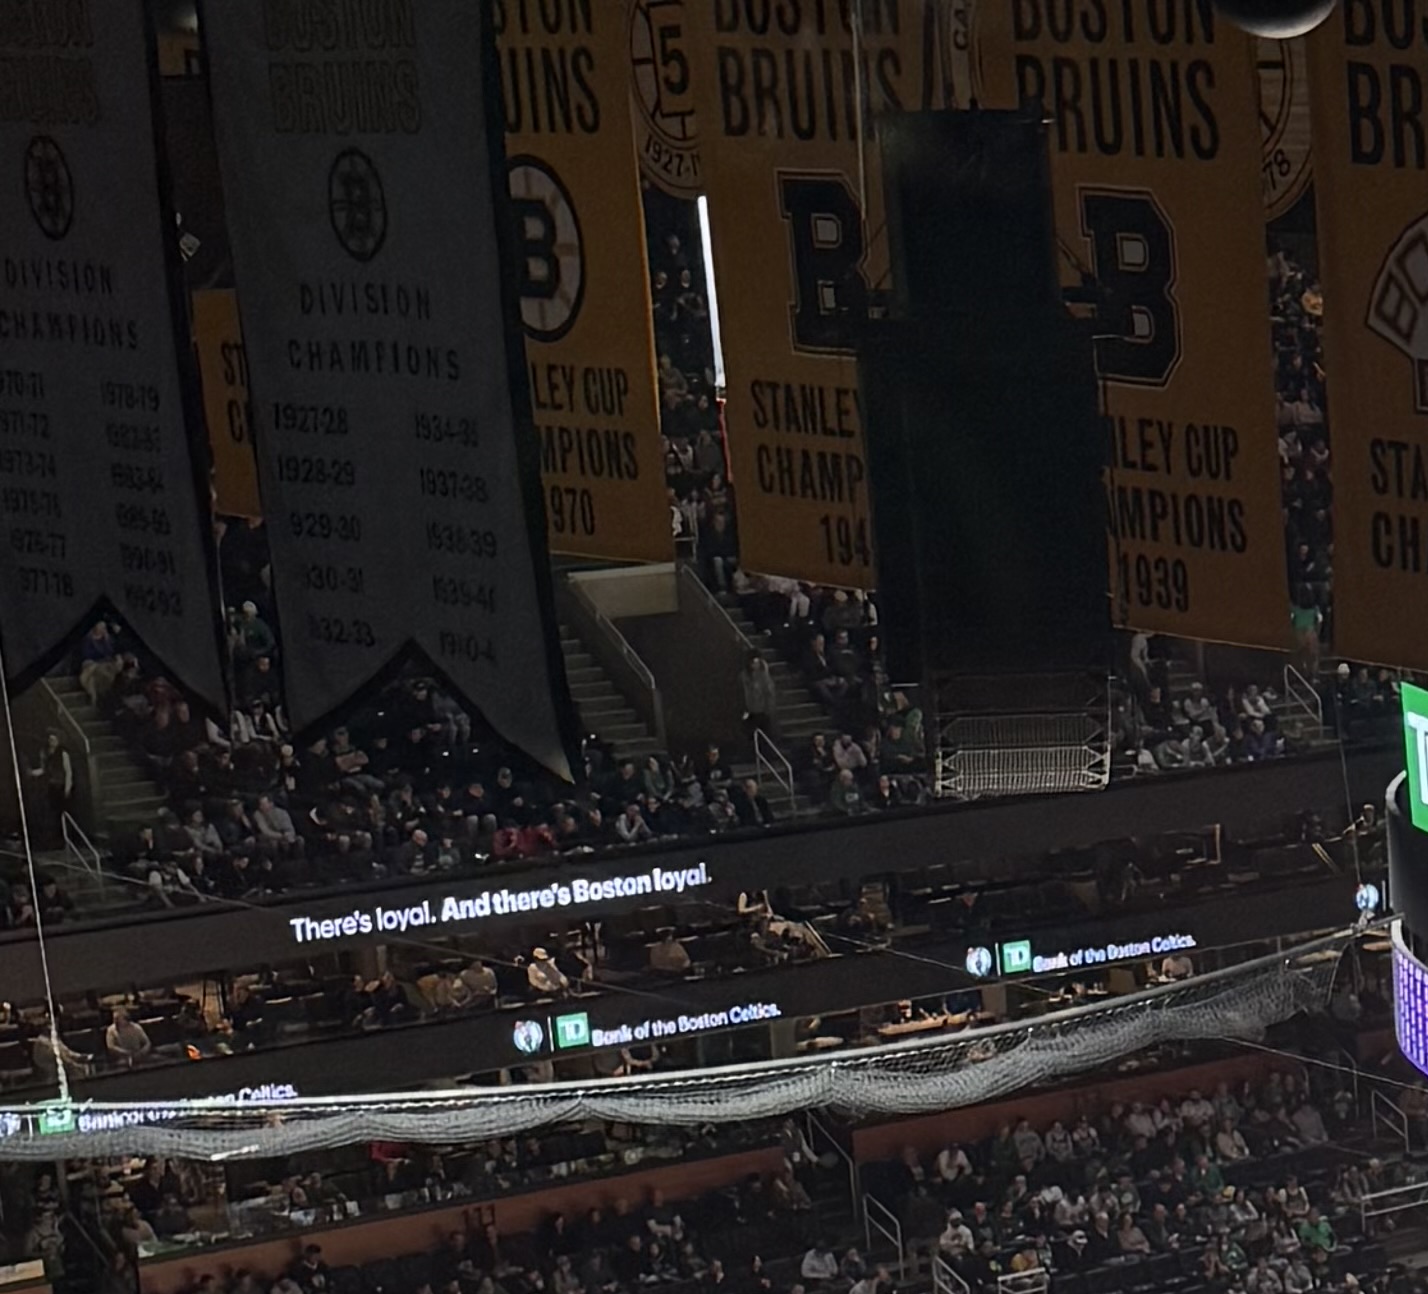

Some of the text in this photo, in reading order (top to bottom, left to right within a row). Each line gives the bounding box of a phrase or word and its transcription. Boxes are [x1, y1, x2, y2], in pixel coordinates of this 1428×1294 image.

[658, 29, 690, 95] 5
[268, 58, 421, 135] BRUINS
[299, 282, 432, 321] DIVISION
[287, 338, 462, 381] CHAMPIONS
[584, 366, 630, 418] CUP
[273, 402, 349, 436] 1927-28
[277, 454, 356, 487] 1928-29
[1184, 421, 1240, 481] CUP
[1119, 552, 1190, 613] 1939
[289, 862, 714, 944] There's loyal. And there's Boston loyal.
[1068, 945, 1107, 967] of the
[591, 1001, 782, 1047] Bank of the Boston Celtics.
